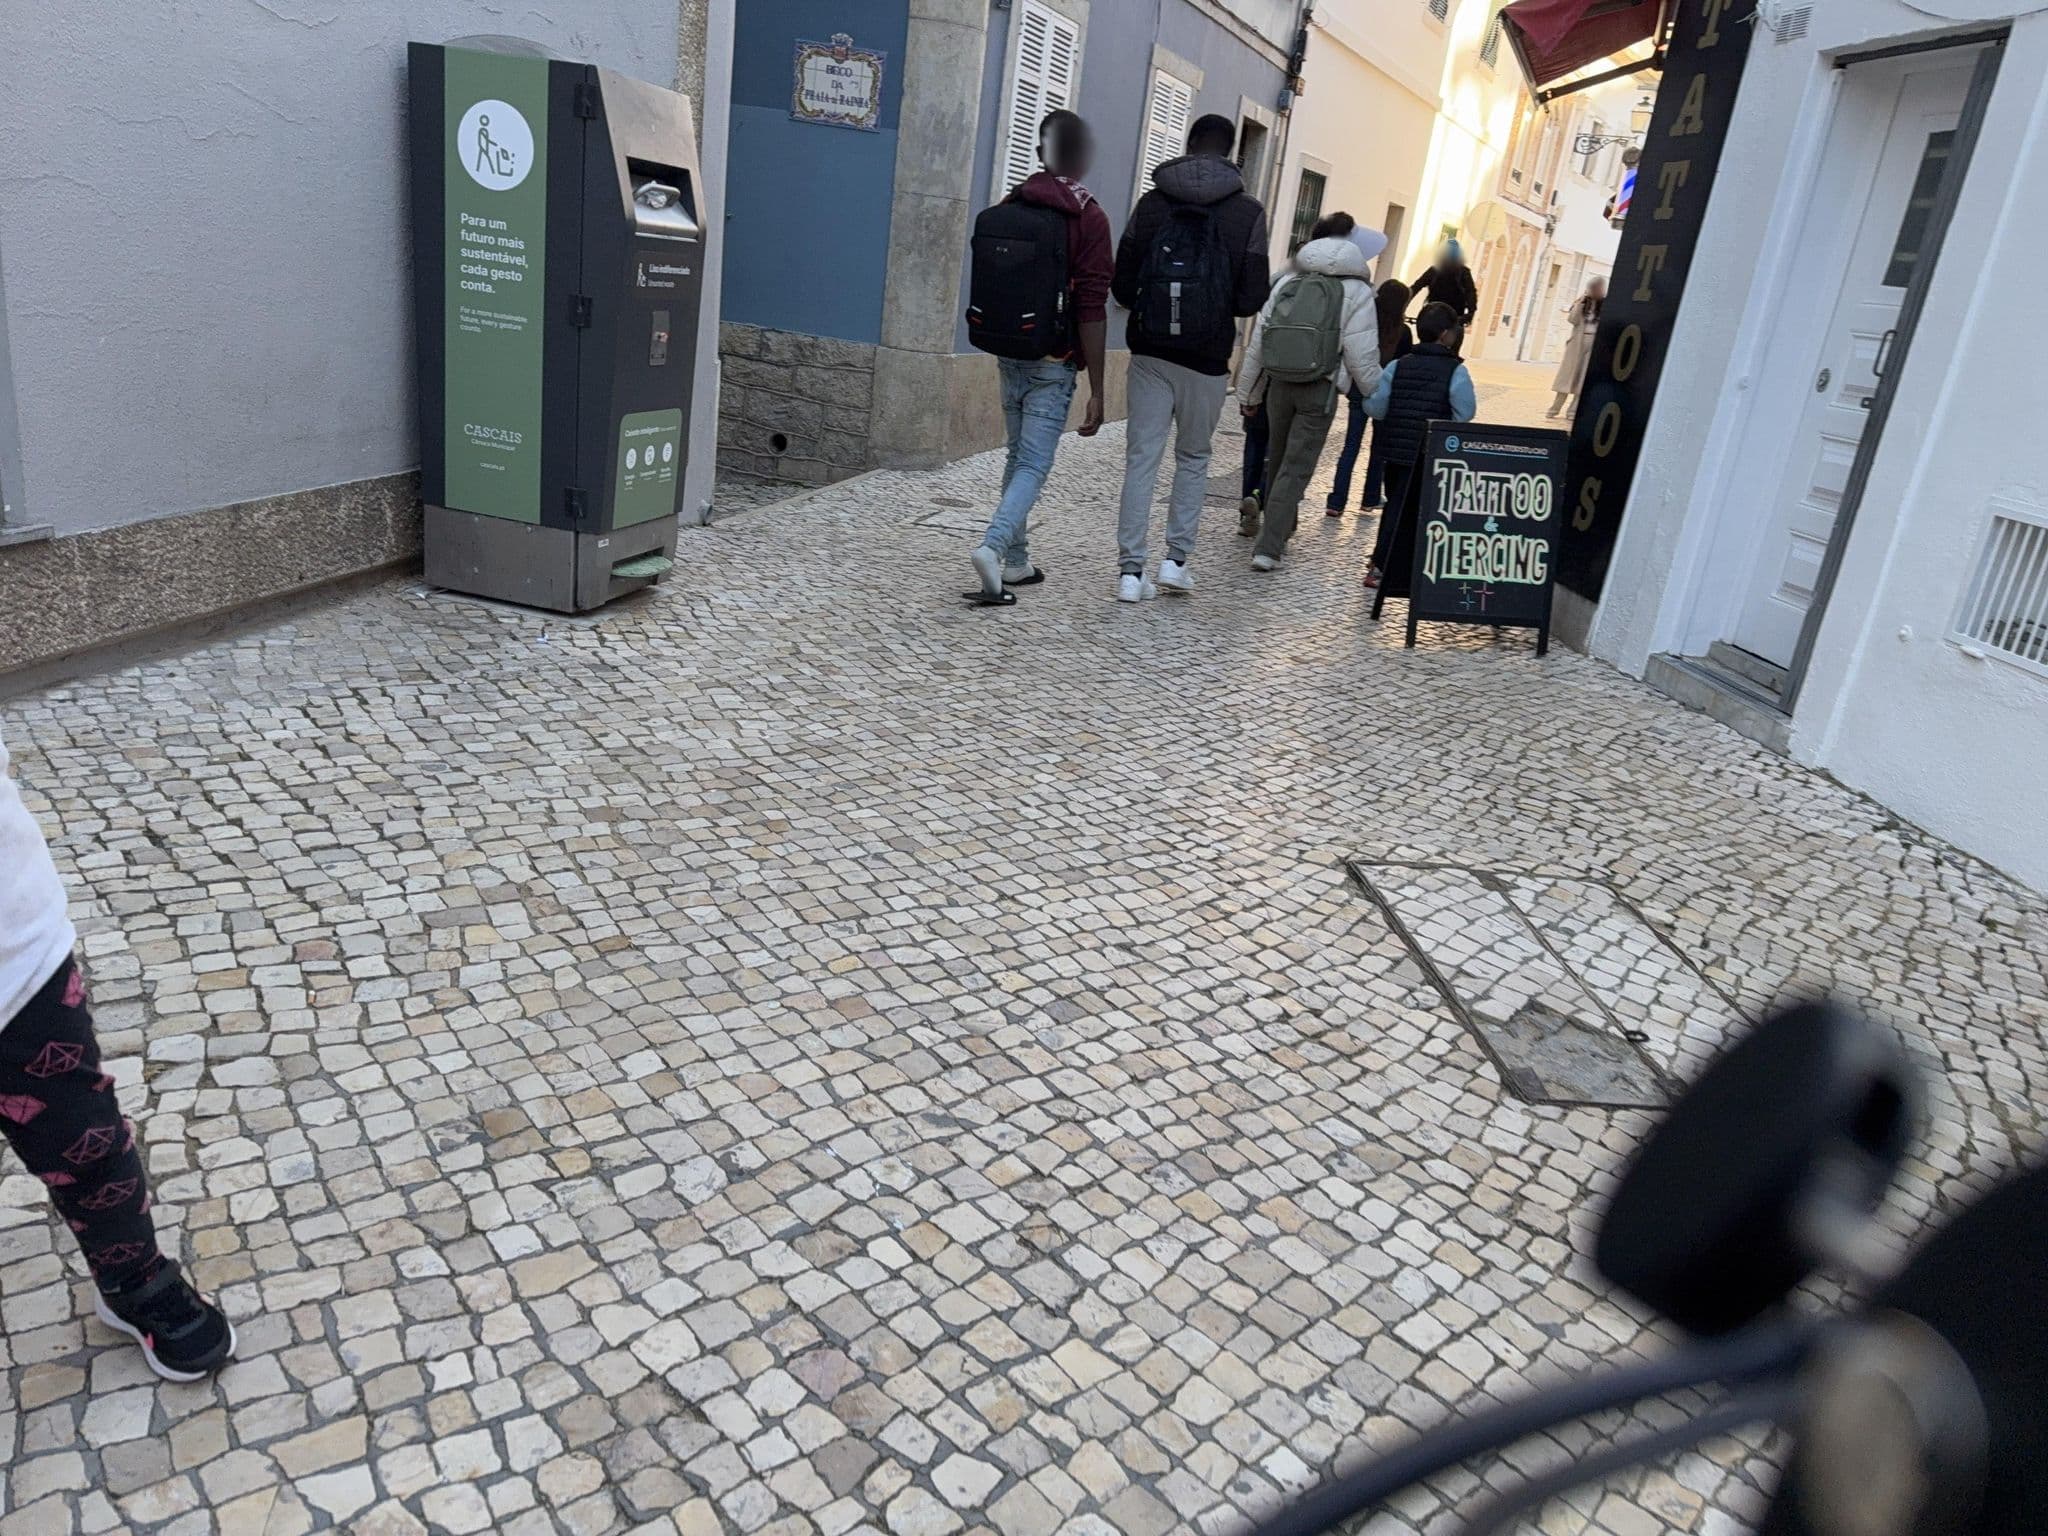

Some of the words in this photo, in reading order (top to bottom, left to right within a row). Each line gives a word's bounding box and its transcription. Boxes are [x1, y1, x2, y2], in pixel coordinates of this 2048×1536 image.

[826, 64, 853, 78] BECO
[831, 80, 843, 90] DA
[461, 212, 486, 228] Para
[488, 218, 507, 231] um
[461, 229, 496, 246] futuro
[497, 236, 525, 250] mais
[460, 247, 529, 269] sustentável,
[1573, 0, 1732, 532] TATTOOS
[460, 263, 489, 277] cada
[490, 268, 523, 282] gesto
[460, 280, 497, 294] conta.
[463, 423, 523, 444] CASCAIS
[1433, 459, 1553, 522] TATTOO
[1484, 516, 1498, 532] &
[1422, 520, 1550, 585] PIERCING
